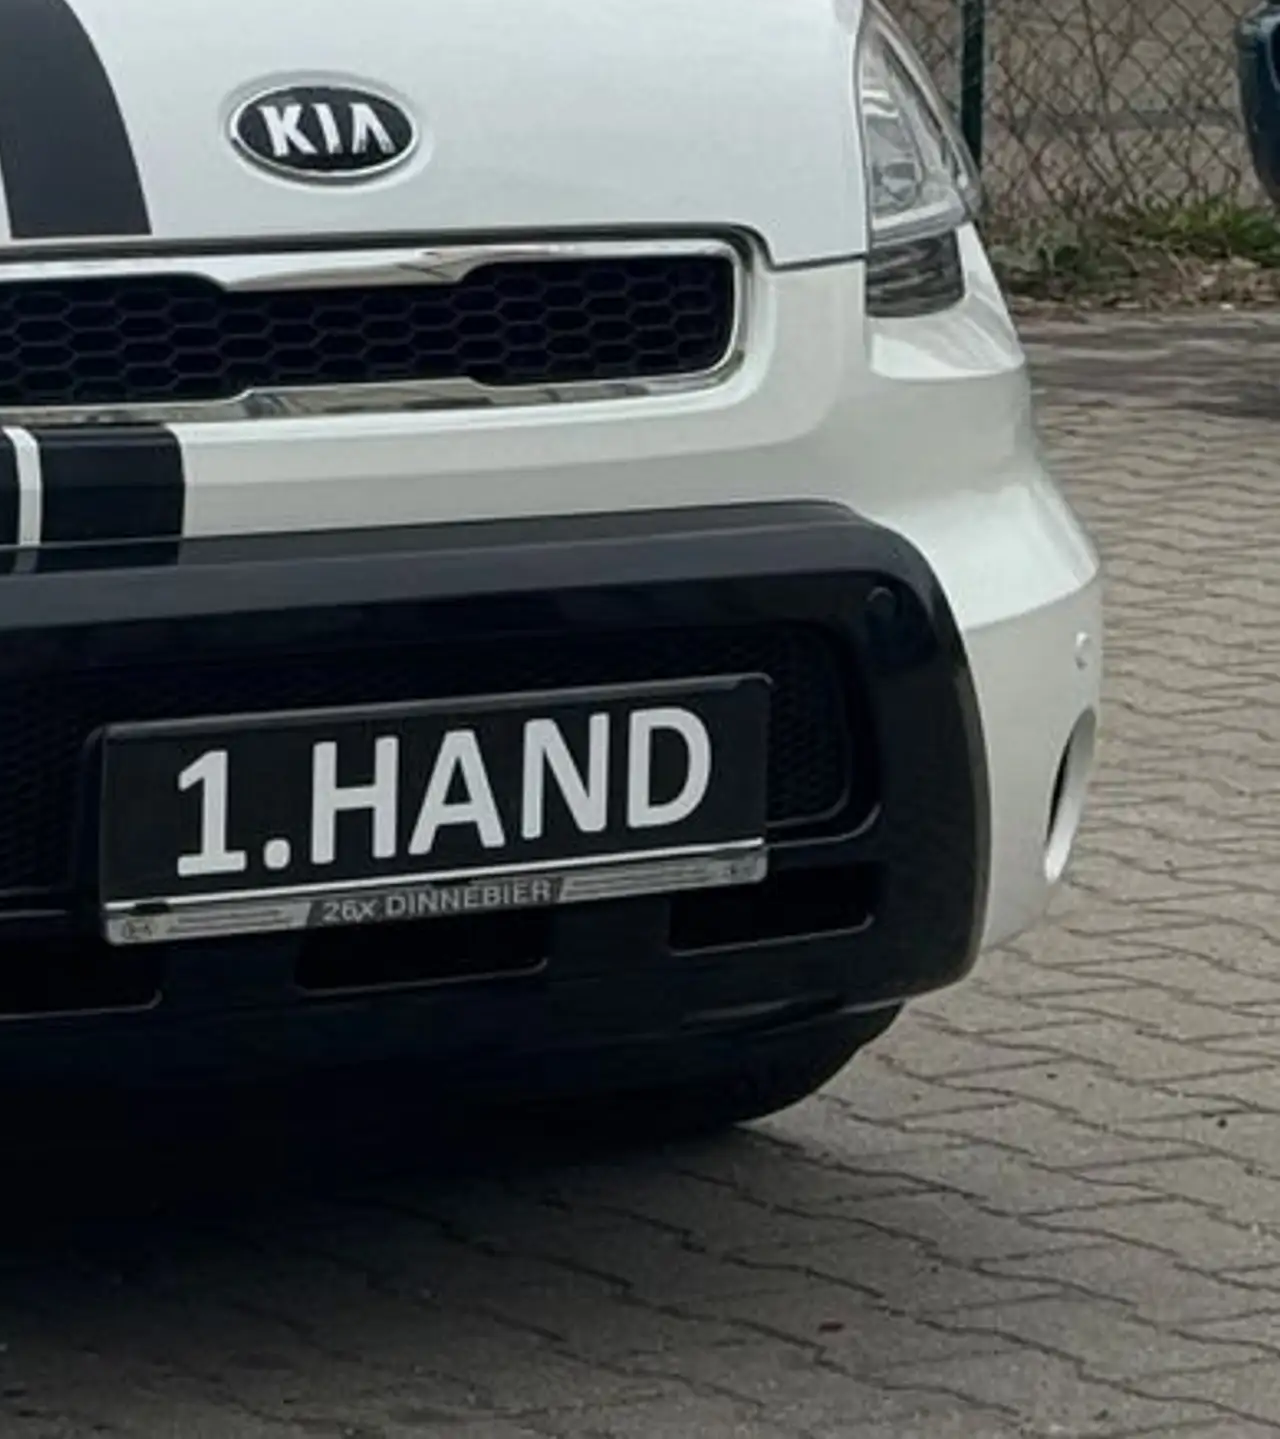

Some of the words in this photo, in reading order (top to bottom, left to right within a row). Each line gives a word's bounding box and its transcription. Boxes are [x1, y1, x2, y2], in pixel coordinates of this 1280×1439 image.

[257, 101, 397, 158] KIA
[176, 706, 713, 878] 1.HAND
[386, 879, 552, 916] DINNEBIER
